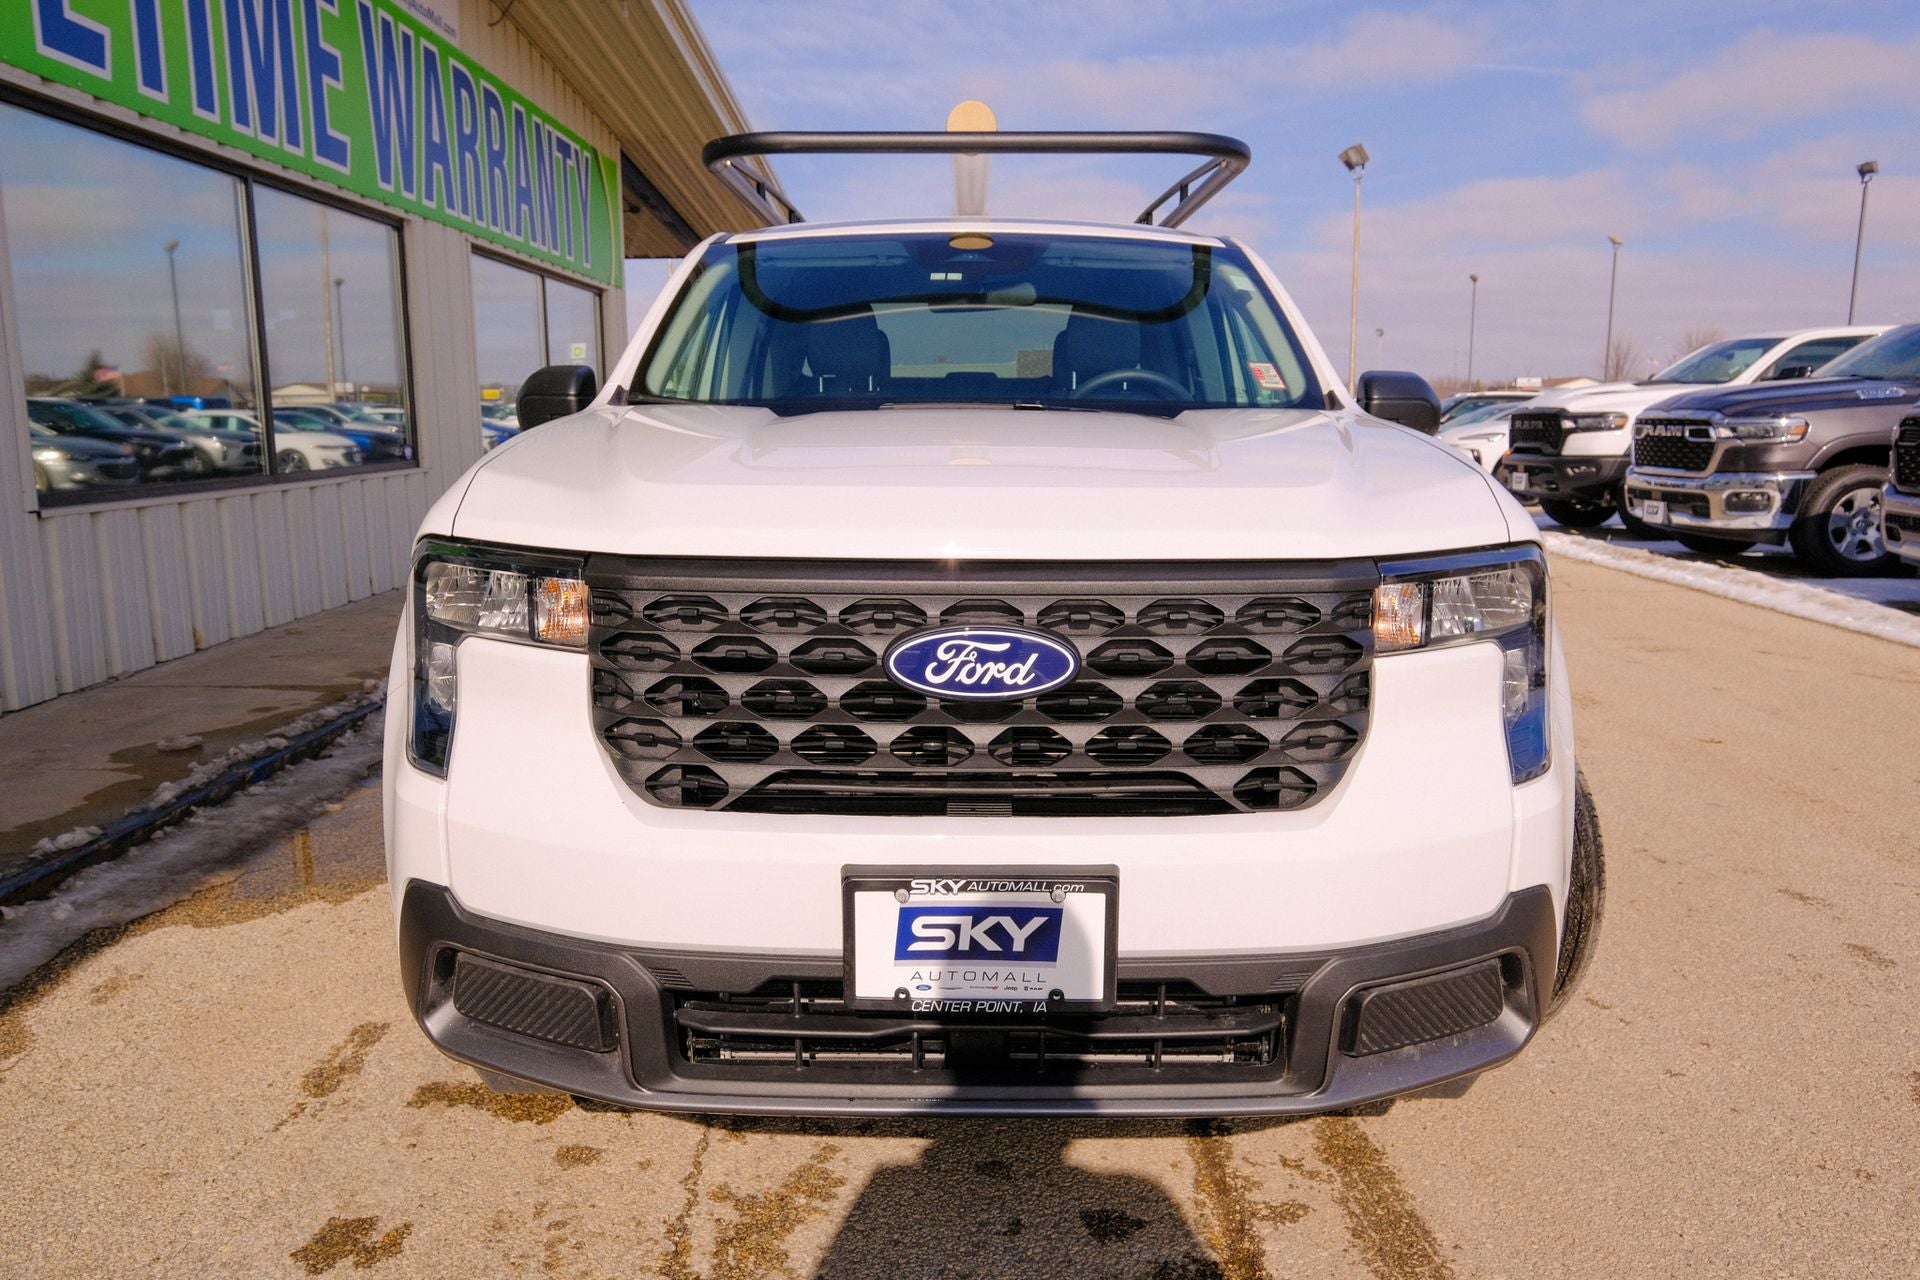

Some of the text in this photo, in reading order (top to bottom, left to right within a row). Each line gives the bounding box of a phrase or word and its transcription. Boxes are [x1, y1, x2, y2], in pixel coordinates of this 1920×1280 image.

[356, 0, 592, 269] WARRANTY
[1646, 425, 1682, 437] RAM
[925, 639, 1039, 686] Ford
[910, 879, 967, 895] SKY
[907, 915, 1049, 952] SKY
[910, 970, 1047, 983] AUTOMALL
[911, 1000, 1047, 1014] CENTER POINT, IA
